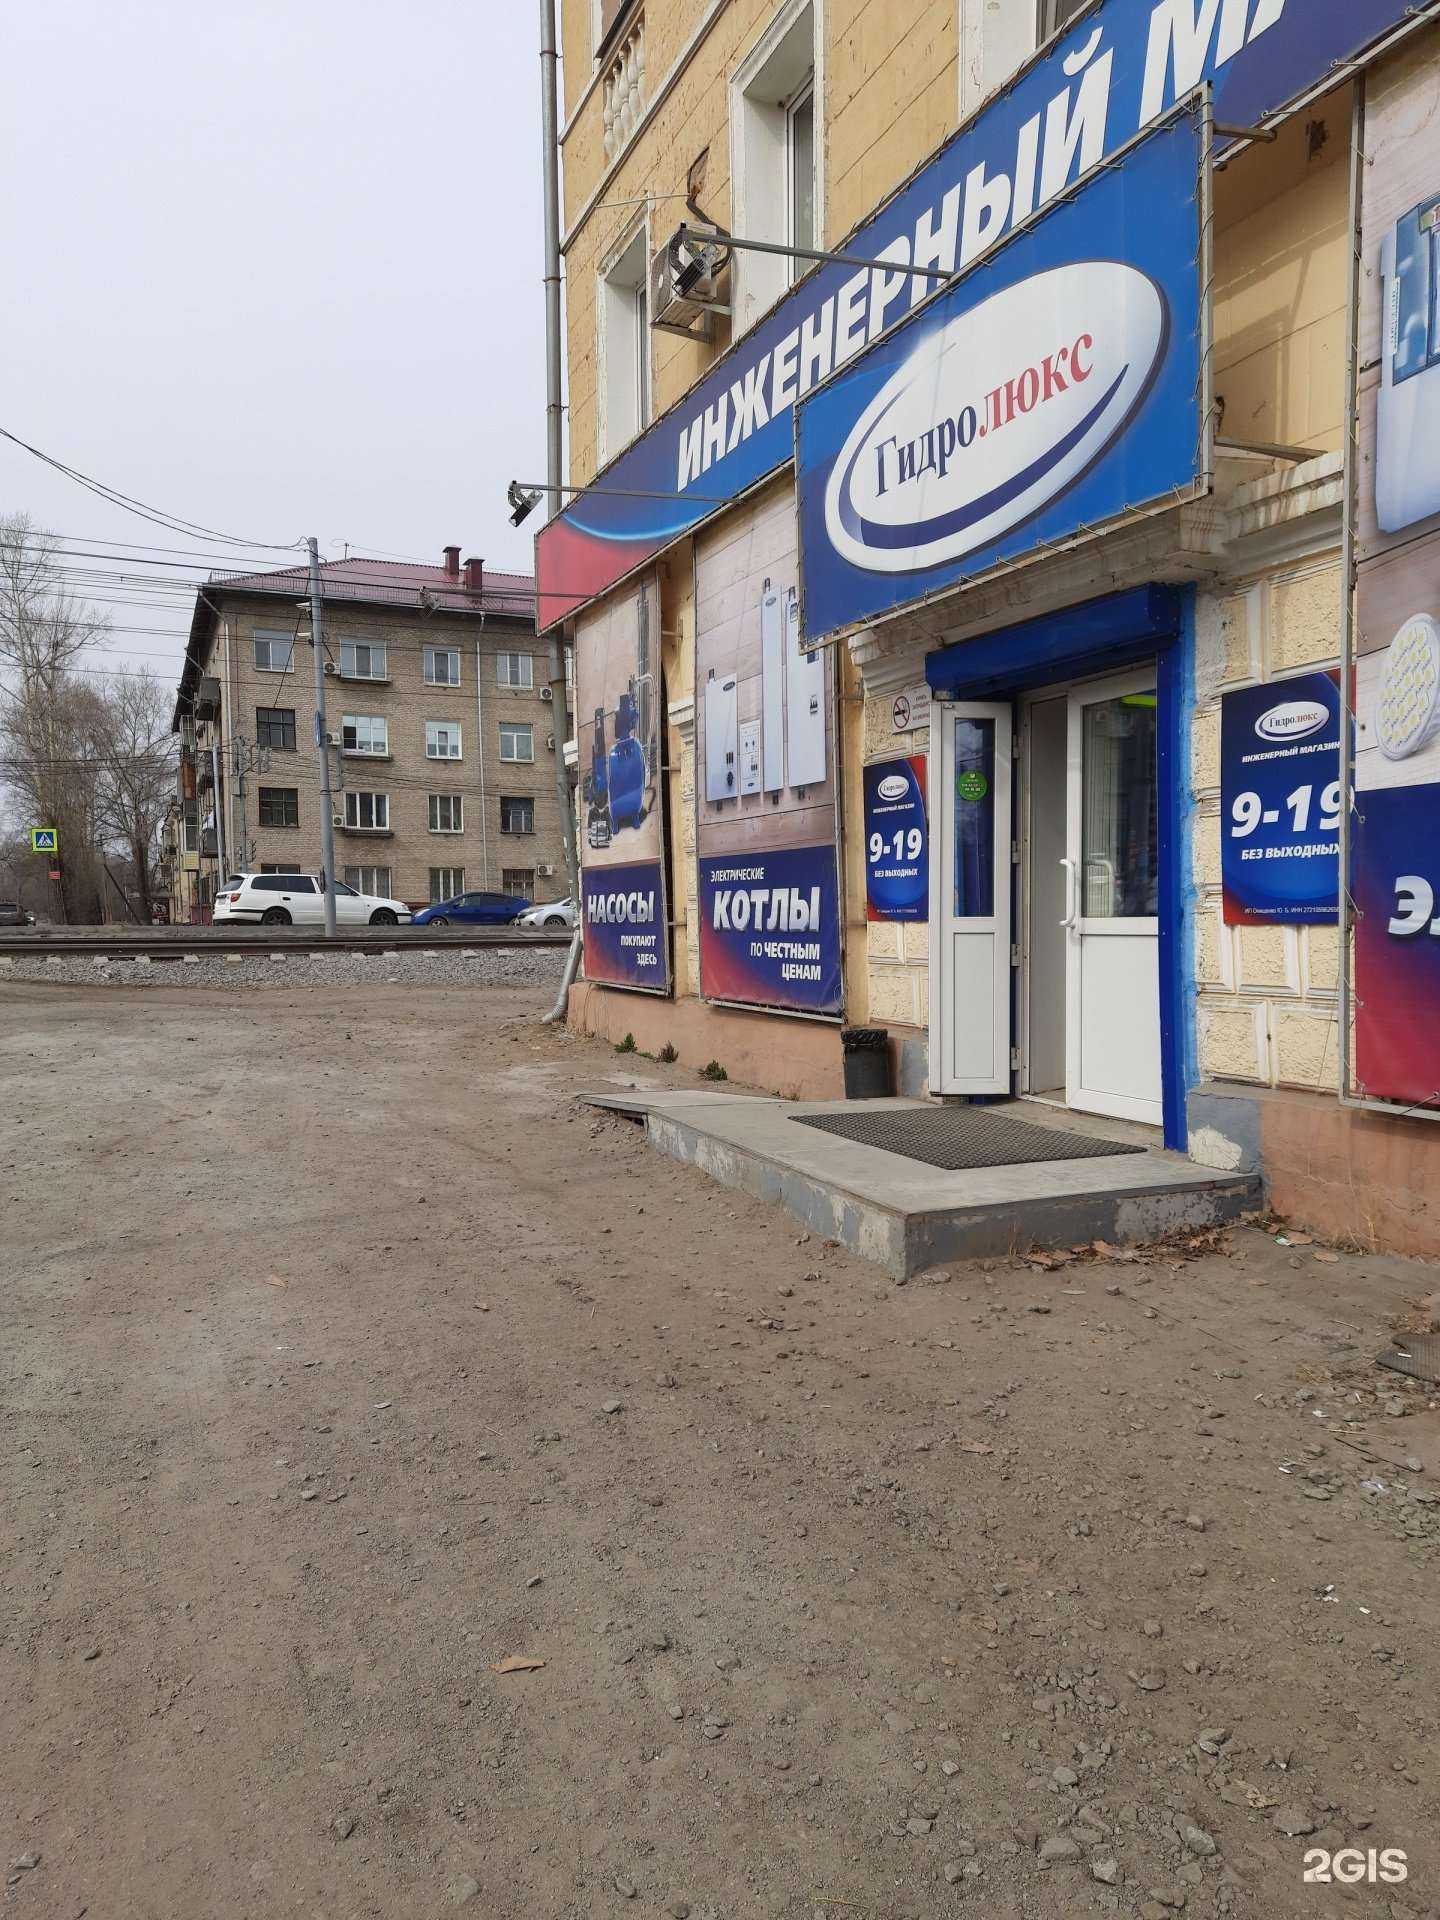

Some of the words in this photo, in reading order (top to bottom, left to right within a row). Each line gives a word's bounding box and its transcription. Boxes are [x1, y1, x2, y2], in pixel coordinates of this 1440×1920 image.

[677, 26, 1114, 492] ИНЖЕНЕРНЫЙ
[1138, 0, 1286, 130] М
[873, 333, 1094, 498] Гидролюкс
[1242, 746, 1299, 763] ИНЖЕНЕРНЫЙ
[1299, 741, 1340, 755] МАГАЗИН
[1231, 780, 1355, 838] 9-19
[869, 828, 923, 863] 9-19
[1241, 848, 1263, 860] БЕЗ
[1265, 843, 1340, 858] ВЫХОДНЫХ
[710, 867, 765, 882] ЭЛЕКТРИЧЕСКИЕ
[587, 891, 655, 924] НАСОСЫ
[713, 886, 821, 933] КОТЛЫ
[1387, 875, 1440, 936] Э
[620, 935, 656, 947] ПОКУПАЮТ
[750, 942, 763, 957] ПО
[763, 942, 820, 960] ЧЕСТНЫМ
[636, 953, 657, 966] ЗДЕСЬ
[782, 963, 821, 981] ЦЕНАМ
